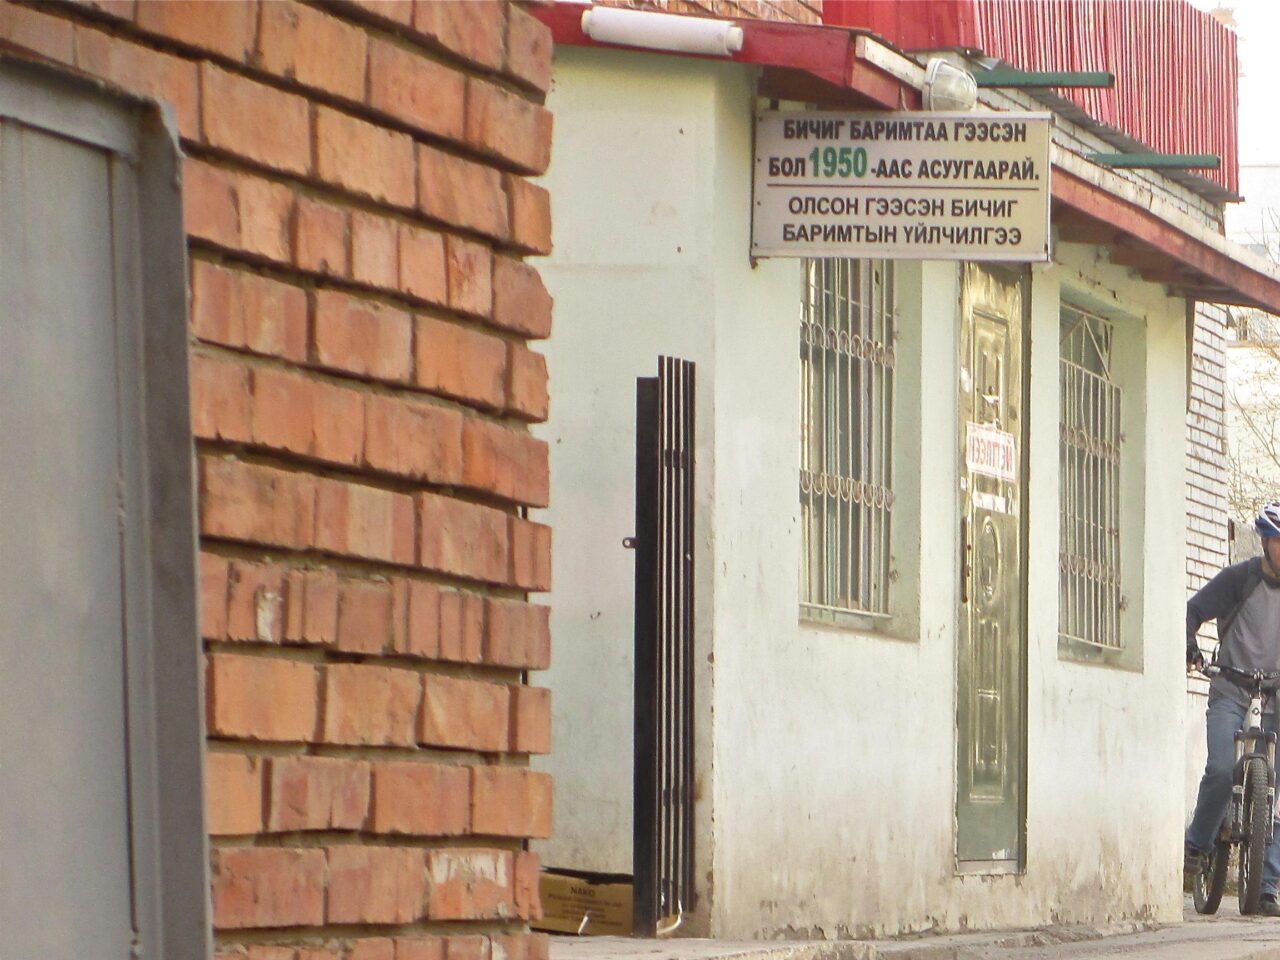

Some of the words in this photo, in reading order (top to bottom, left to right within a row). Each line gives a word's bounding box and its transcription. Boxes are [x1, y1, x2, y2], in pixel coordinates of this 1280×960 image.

[783, 119, 845, 140] БИЧИГ
[850, 120, 948, 141] БАРИМТАА
[954, 121, 1027, 142] ГЭЭСЭН
[768, 157, 806, 177] БОЛ
[809, 147, 868, 178] 1950
[917, 156, 1040, 180] АСУУГААРАЙ.
[788, 196, 859, 215] ОЛСОН
[865, 198, 945, 217] ГЭЭСЭН
[951, 199, 1019, 218] БИЧИГ
[782, 223, 897, 243] БАРИМТЫН
[904, 222, 1022, 245] ҮЙЛЧИЛГЭЭ
